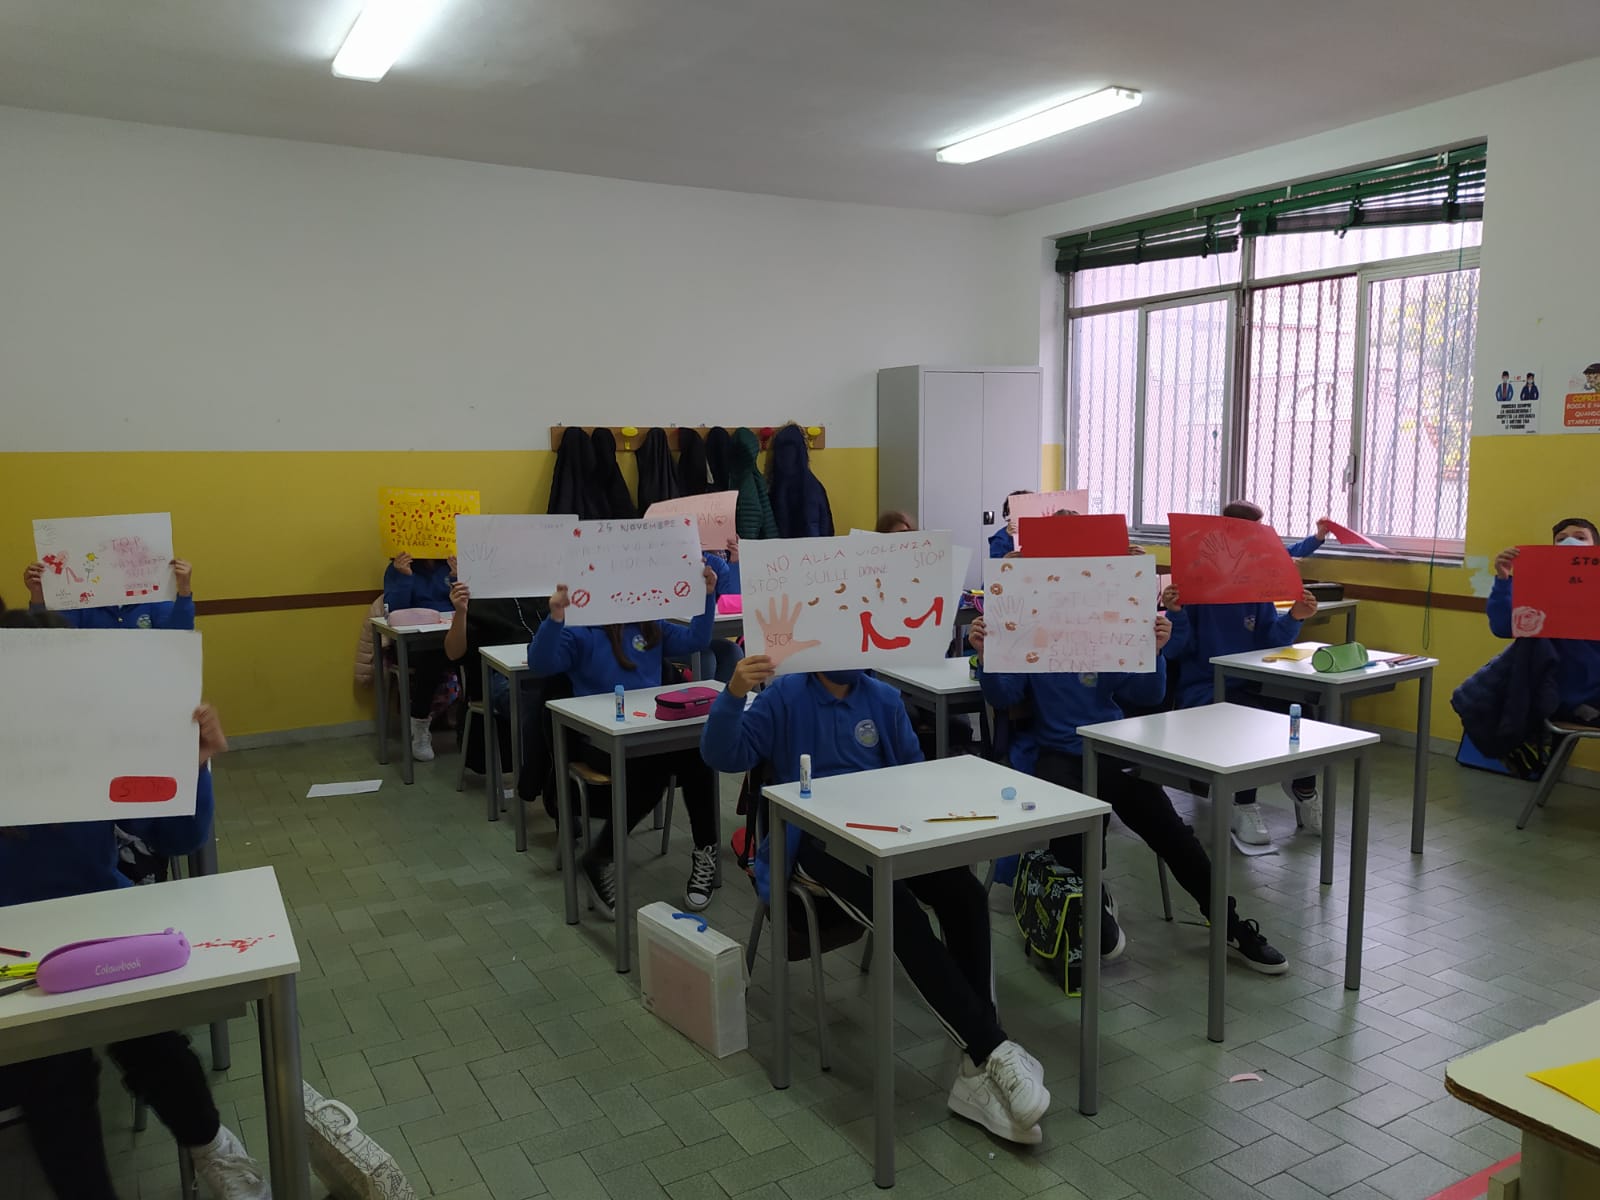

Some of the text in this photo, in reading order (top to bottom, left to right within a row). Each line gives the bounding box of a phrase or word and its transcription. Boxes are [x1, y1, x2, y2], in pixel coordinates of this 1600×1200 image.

[395, 519, 456, 534] VIOLENZ
[765, 538, 932, 576] NO ALLA VIOLENZA
[749, 576, 787, 596] STOP
[912, 550, 945, 569] STOP
[765, 632, 793, 648] STOP
